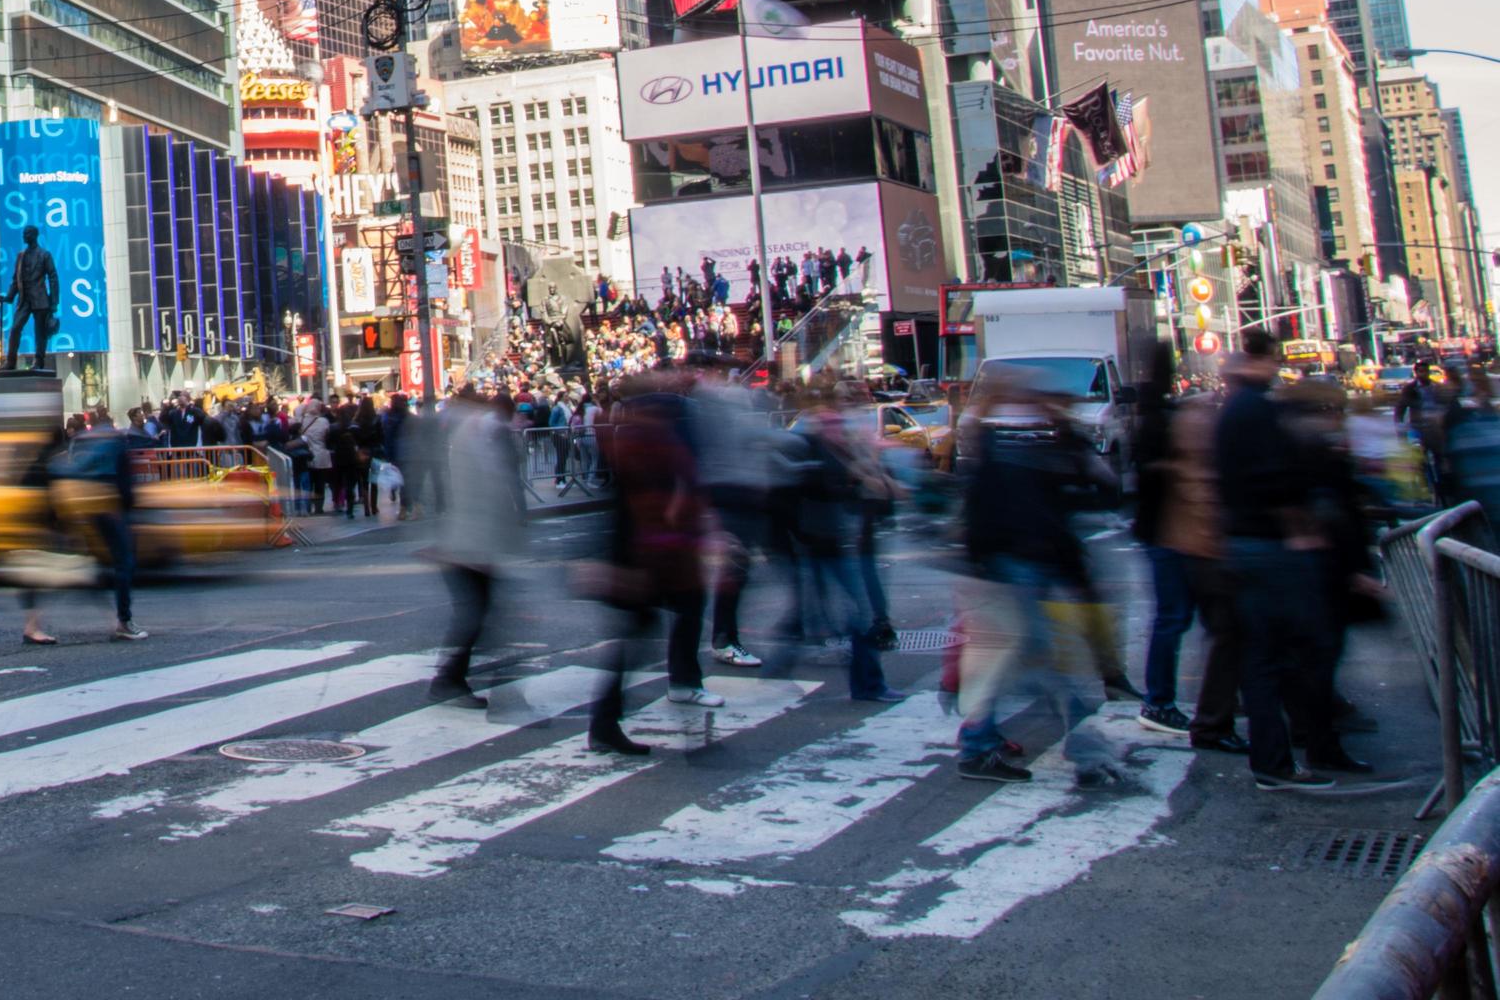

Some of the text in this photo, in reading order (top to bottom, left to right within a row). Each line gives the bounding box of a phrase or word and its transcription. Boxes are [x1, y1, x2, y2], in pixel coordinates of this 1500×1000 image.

[1085, 18, 1169, 37] America's
[1073, 41, 1185, 62] Favorite Nut.
[702, 56, 845, 97] HYUNDAI
[19, 171, 89, 185] Morgan Stanley
[754, 241, 810, 255] RSEARCH
[137, 306, 255, 359] 1585 B
